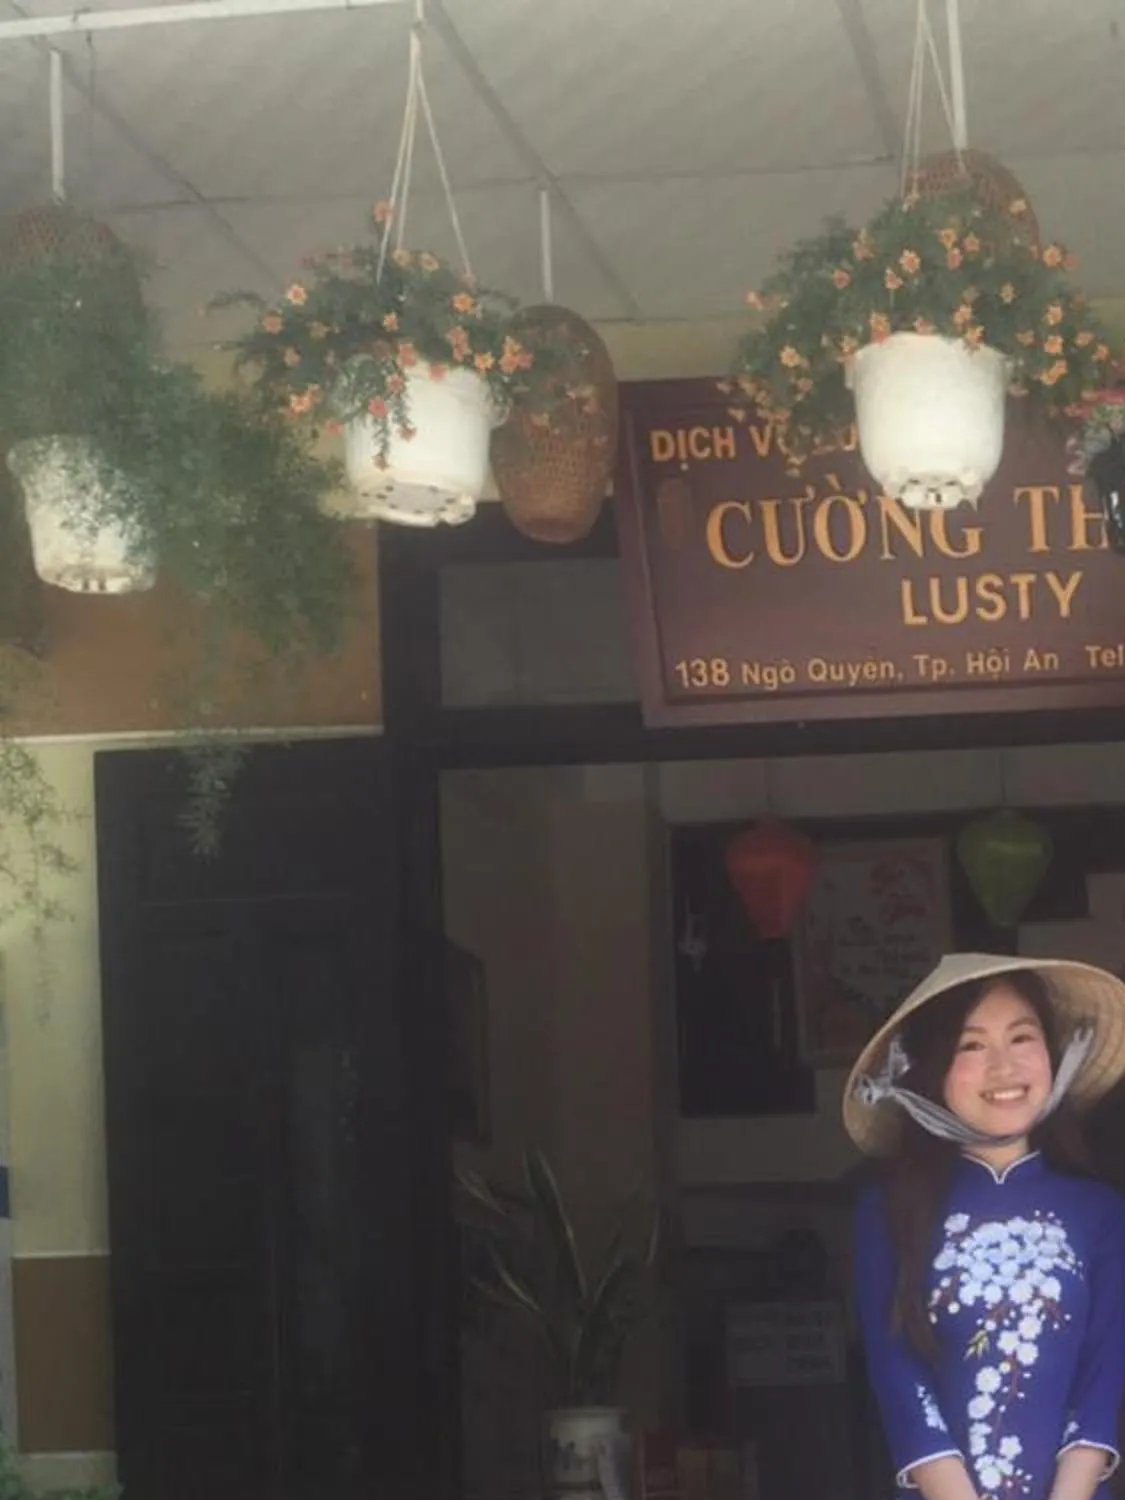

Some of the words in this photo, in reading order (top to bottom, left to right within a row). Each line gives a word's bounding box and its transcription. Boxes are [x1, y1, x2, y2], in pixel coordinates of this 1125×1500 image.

[651, 426, 736, 471] DỊCH
[706, 472, 984, 569] CƯỜNG
[901, 570, 1084, 627] LUSTY
[675, 656, 730, 688] 138
[912, 653, 956, 682] Tp.
[1023, 648, 1059, 671] An
